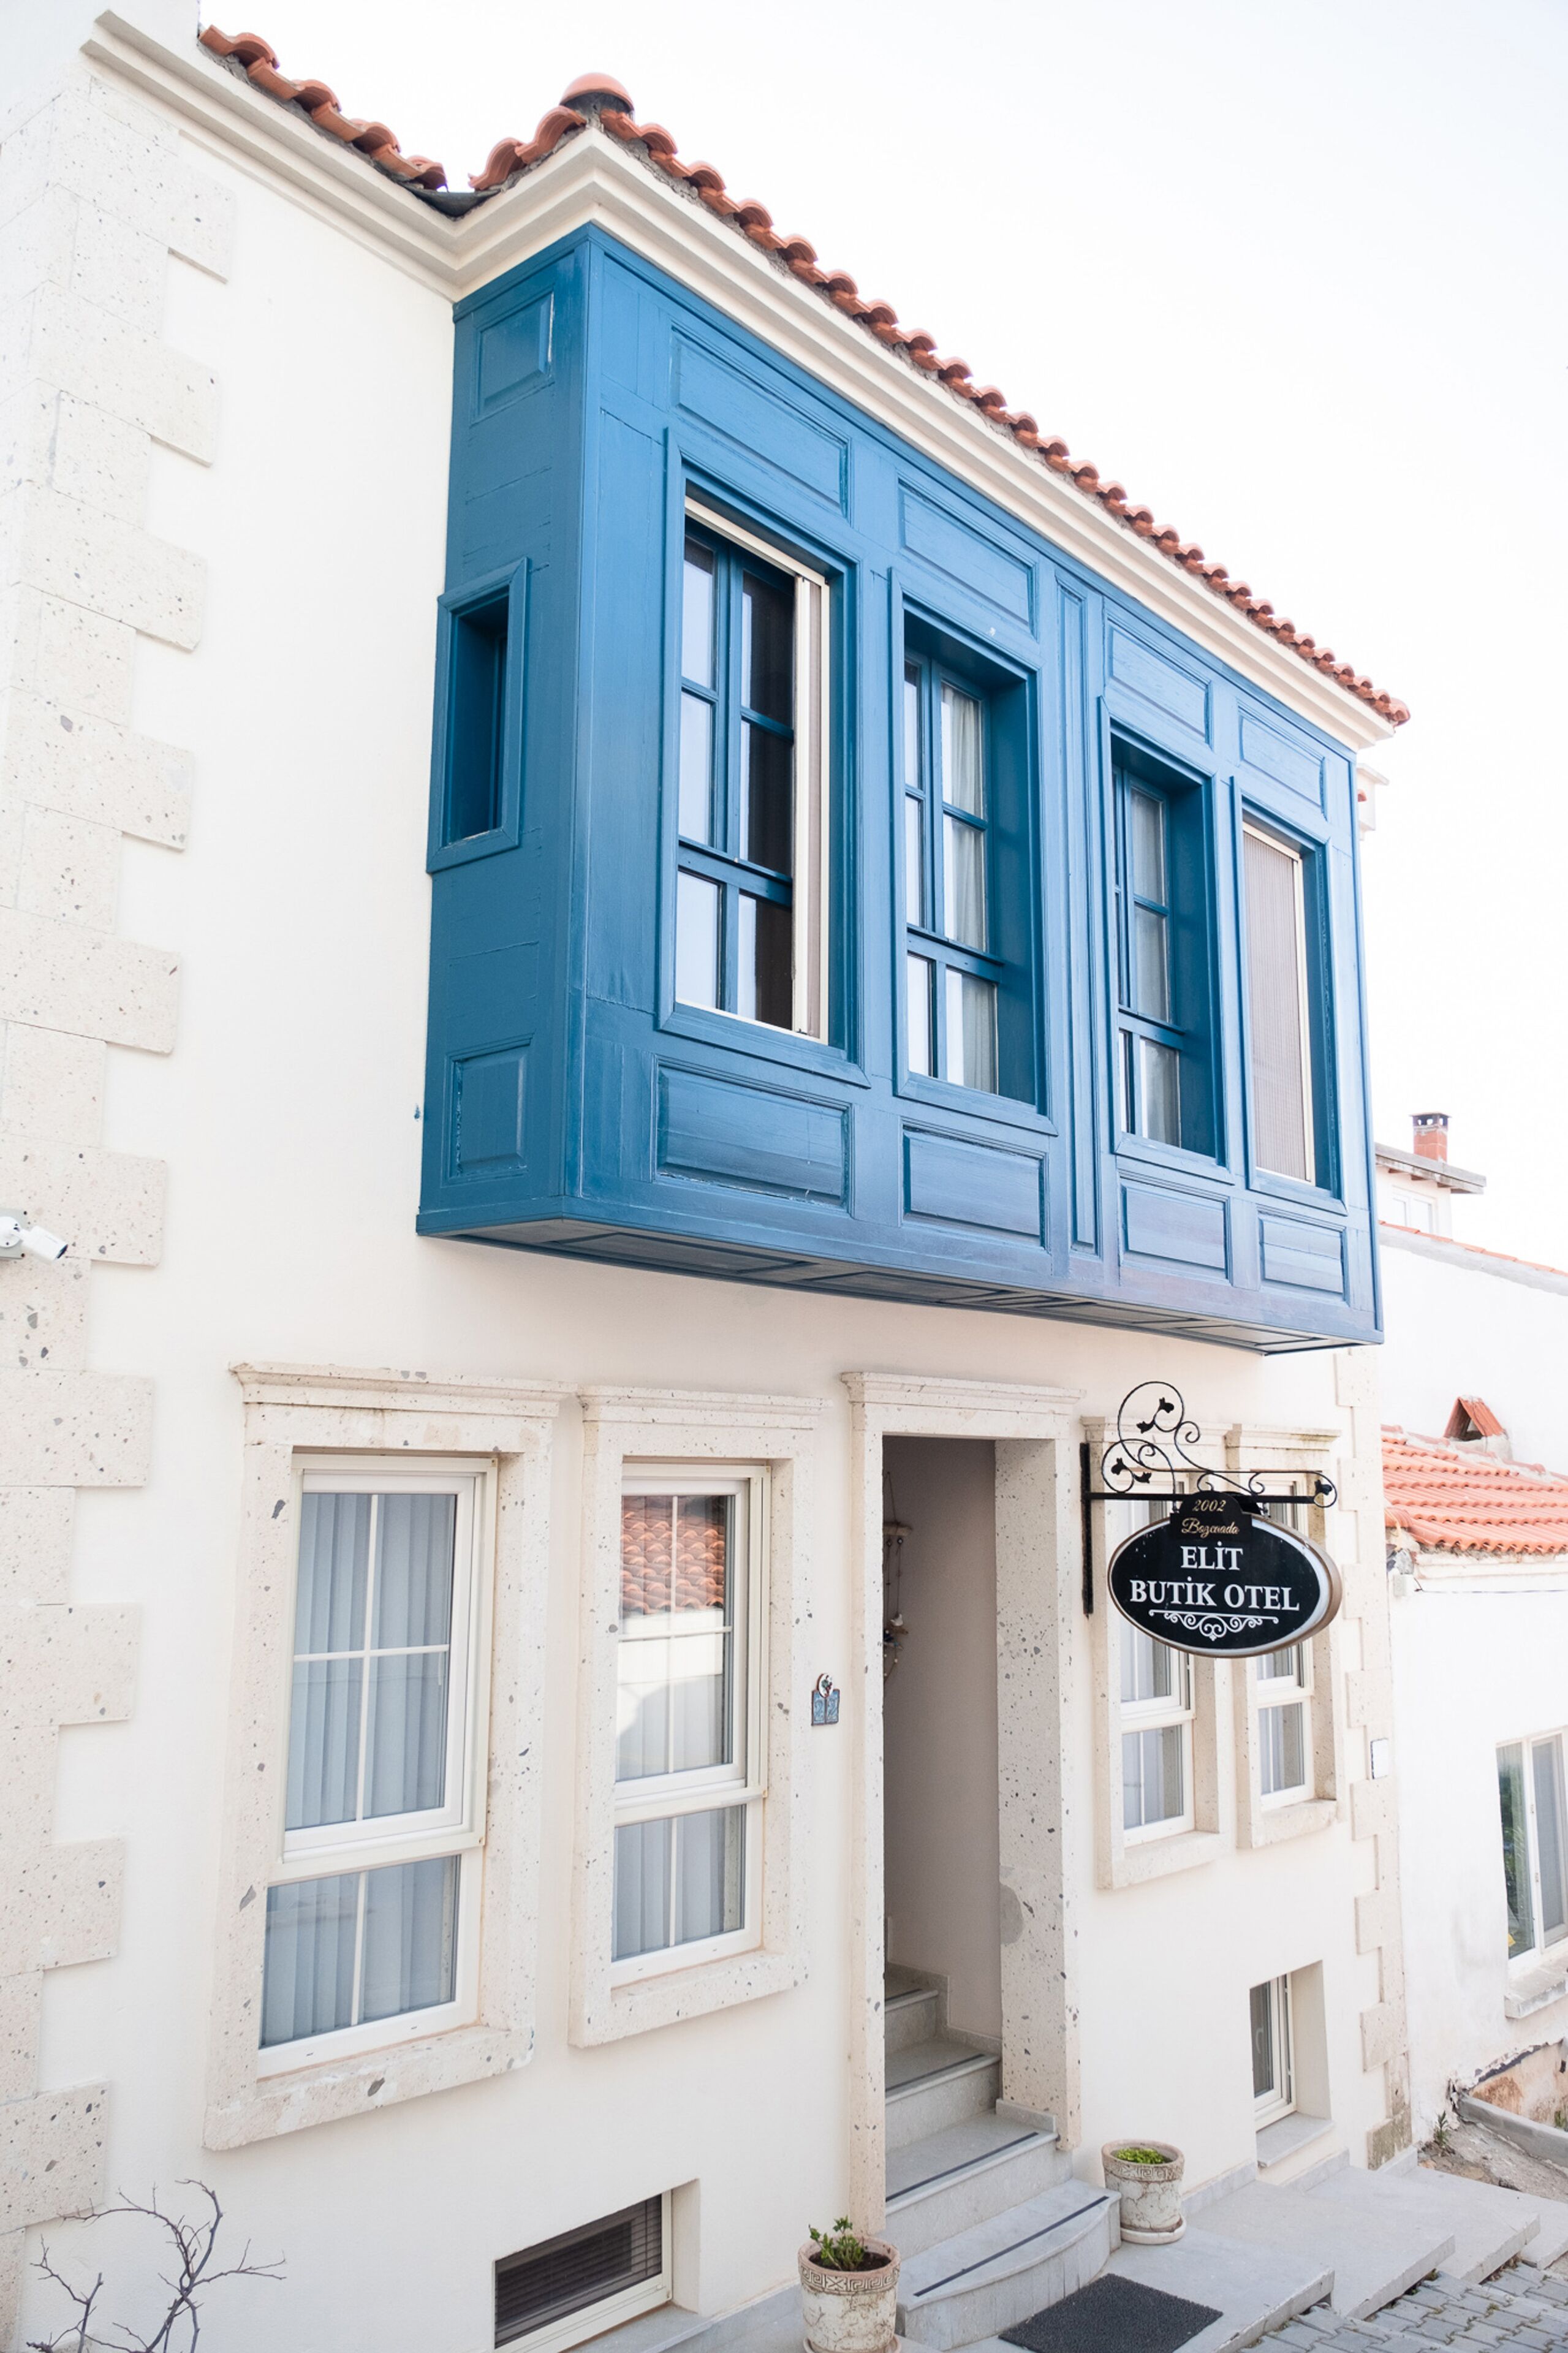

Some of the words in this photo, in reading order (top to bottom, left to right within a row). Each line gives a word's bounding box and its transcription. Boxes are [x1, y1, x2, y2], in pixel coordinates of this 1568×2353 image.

[1192, 1499, 1226, 1512] 2002
[1180, 1541, 1243, 1571] ELİT
[1130, 1577, 1217, 1607] BUTİK
[1225, 1585, 1300, 1611] OTEL
